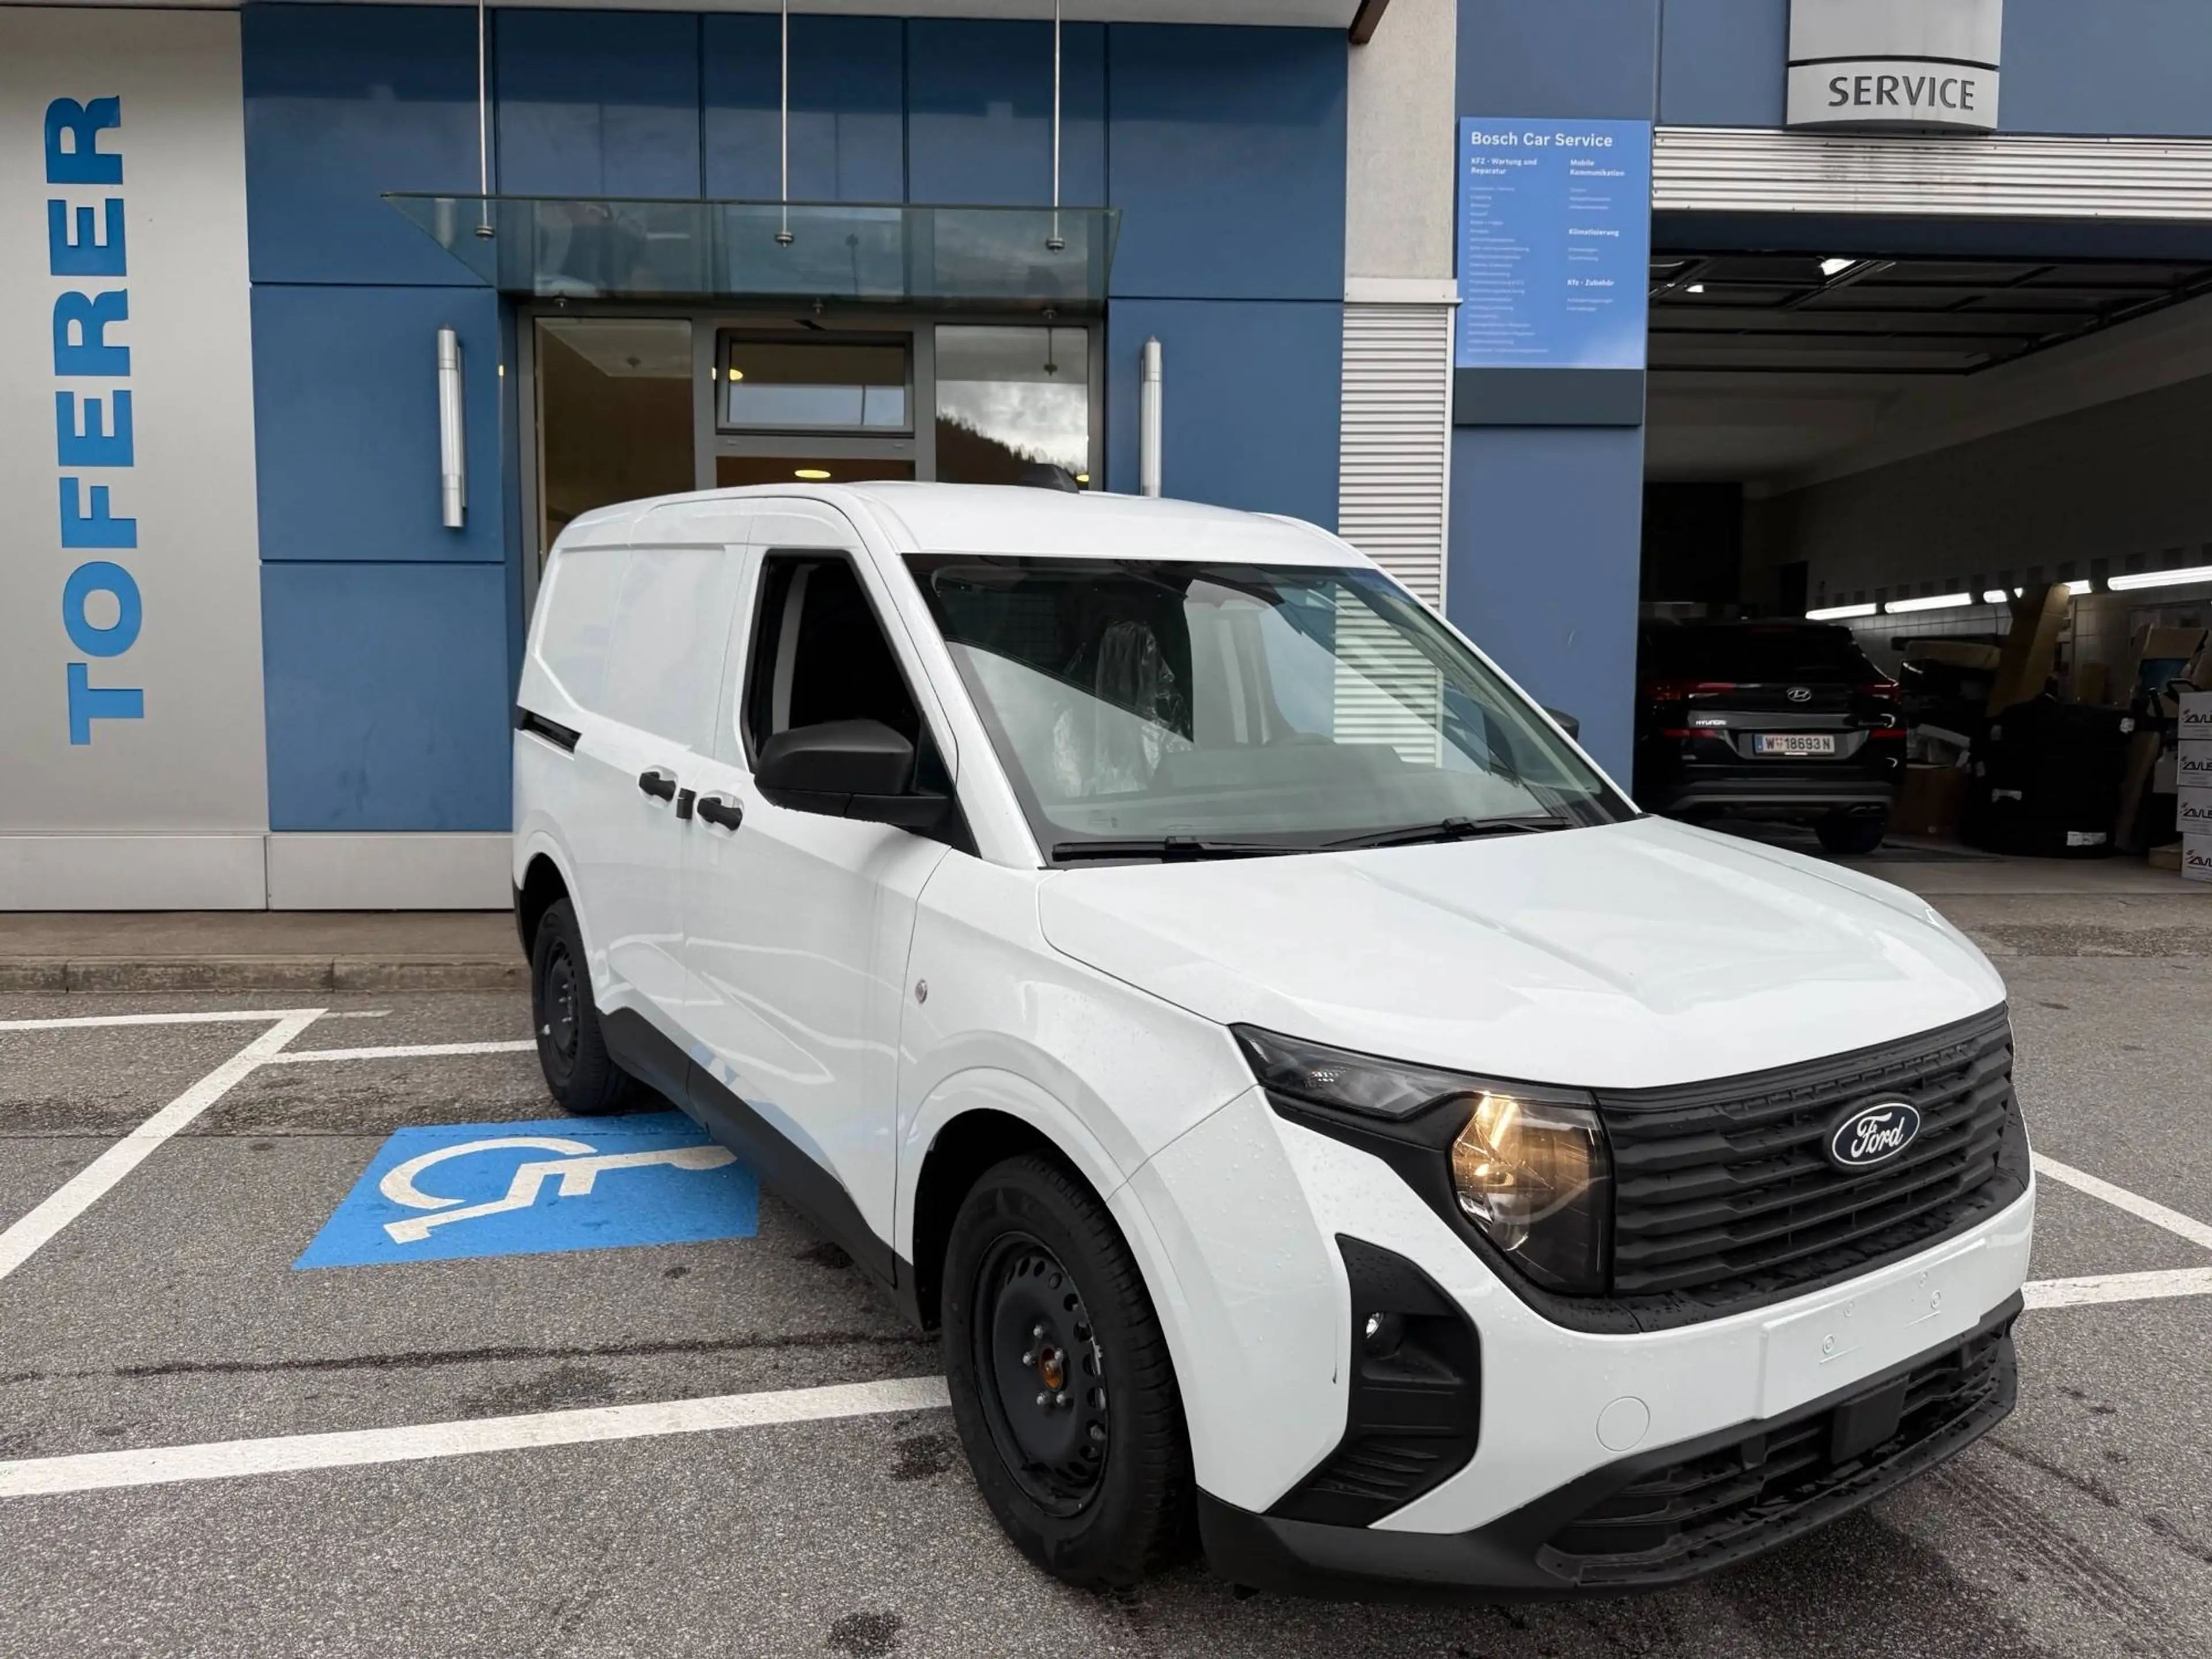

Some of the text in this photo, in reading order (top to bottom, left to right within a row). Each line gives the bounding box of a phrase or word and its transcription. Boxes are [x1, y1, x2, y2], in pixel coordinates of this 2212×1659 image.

[1828, 75, 1975, 111] SERVICE
[1471, 131, 1613, 147] Bosch Car Service
[1491, 158, 1522, 166] Wartung
[44, 95, 144, 745] TOFERER
[1851, 1112, 1906, 1158] Ford
